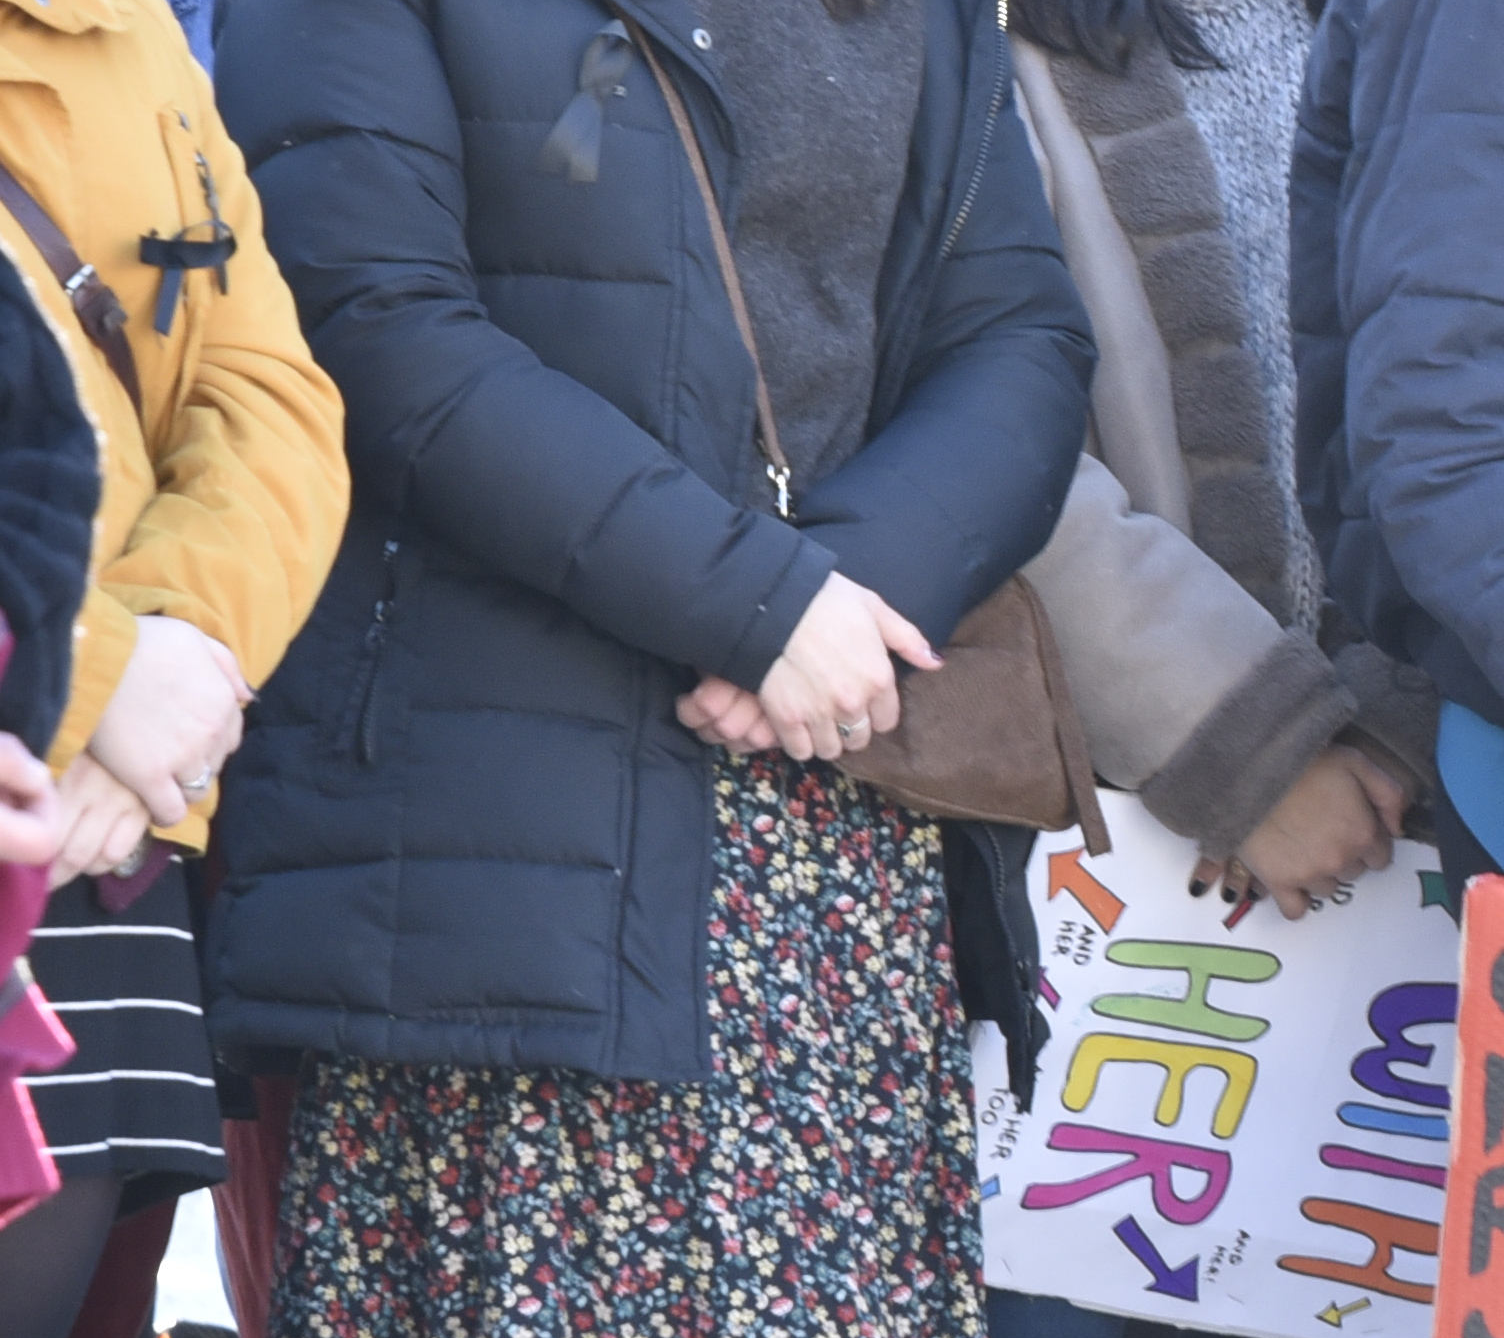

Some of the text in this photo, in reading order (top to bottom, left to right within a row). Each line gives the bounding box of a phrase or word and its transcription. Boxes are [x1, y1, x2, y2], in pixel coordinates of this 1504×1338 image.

[1050, 919, 1077, 957] HER
[1073, 924, 1096, 967] AND
[1020, 938, 1282, 1225] HER
